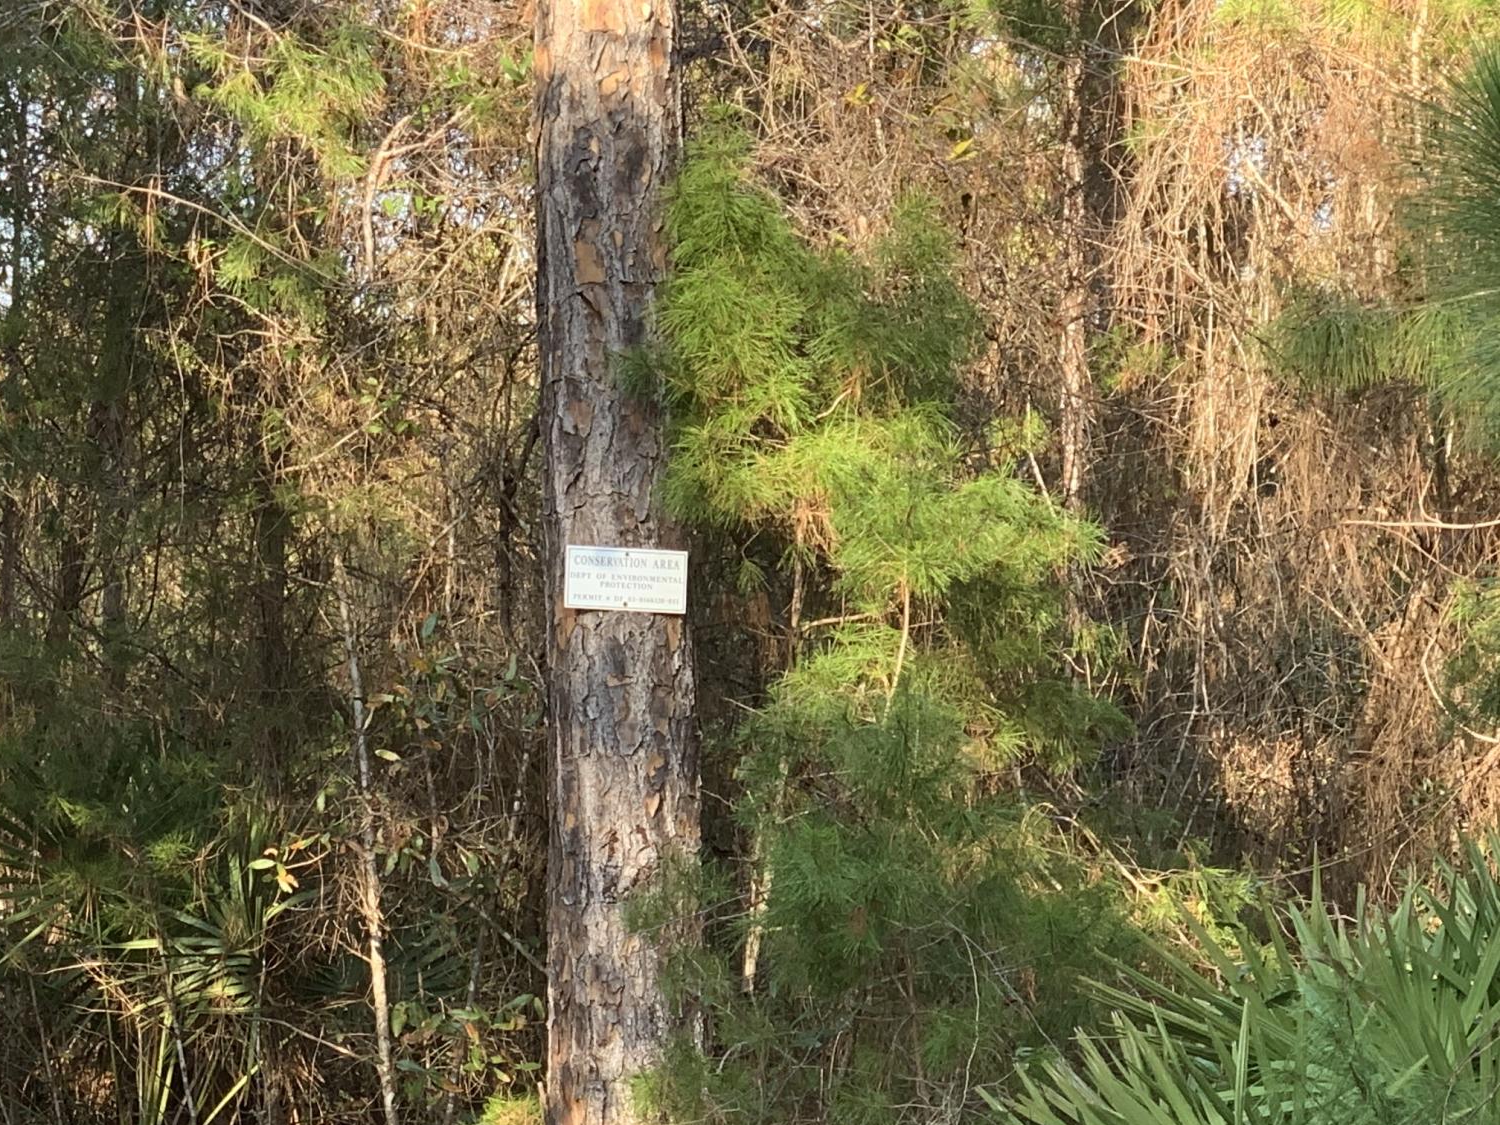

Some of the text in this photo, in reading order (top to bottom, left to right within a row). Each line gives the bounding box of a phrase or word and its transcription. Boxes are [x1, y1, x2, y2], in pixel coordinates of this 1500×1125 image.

[574, 555, 680, 570] CONSERVATION AREA
[611, 575, 683, 584] ENVIRONMENTAL
[599, 581, 653, 590] PROTECTION
